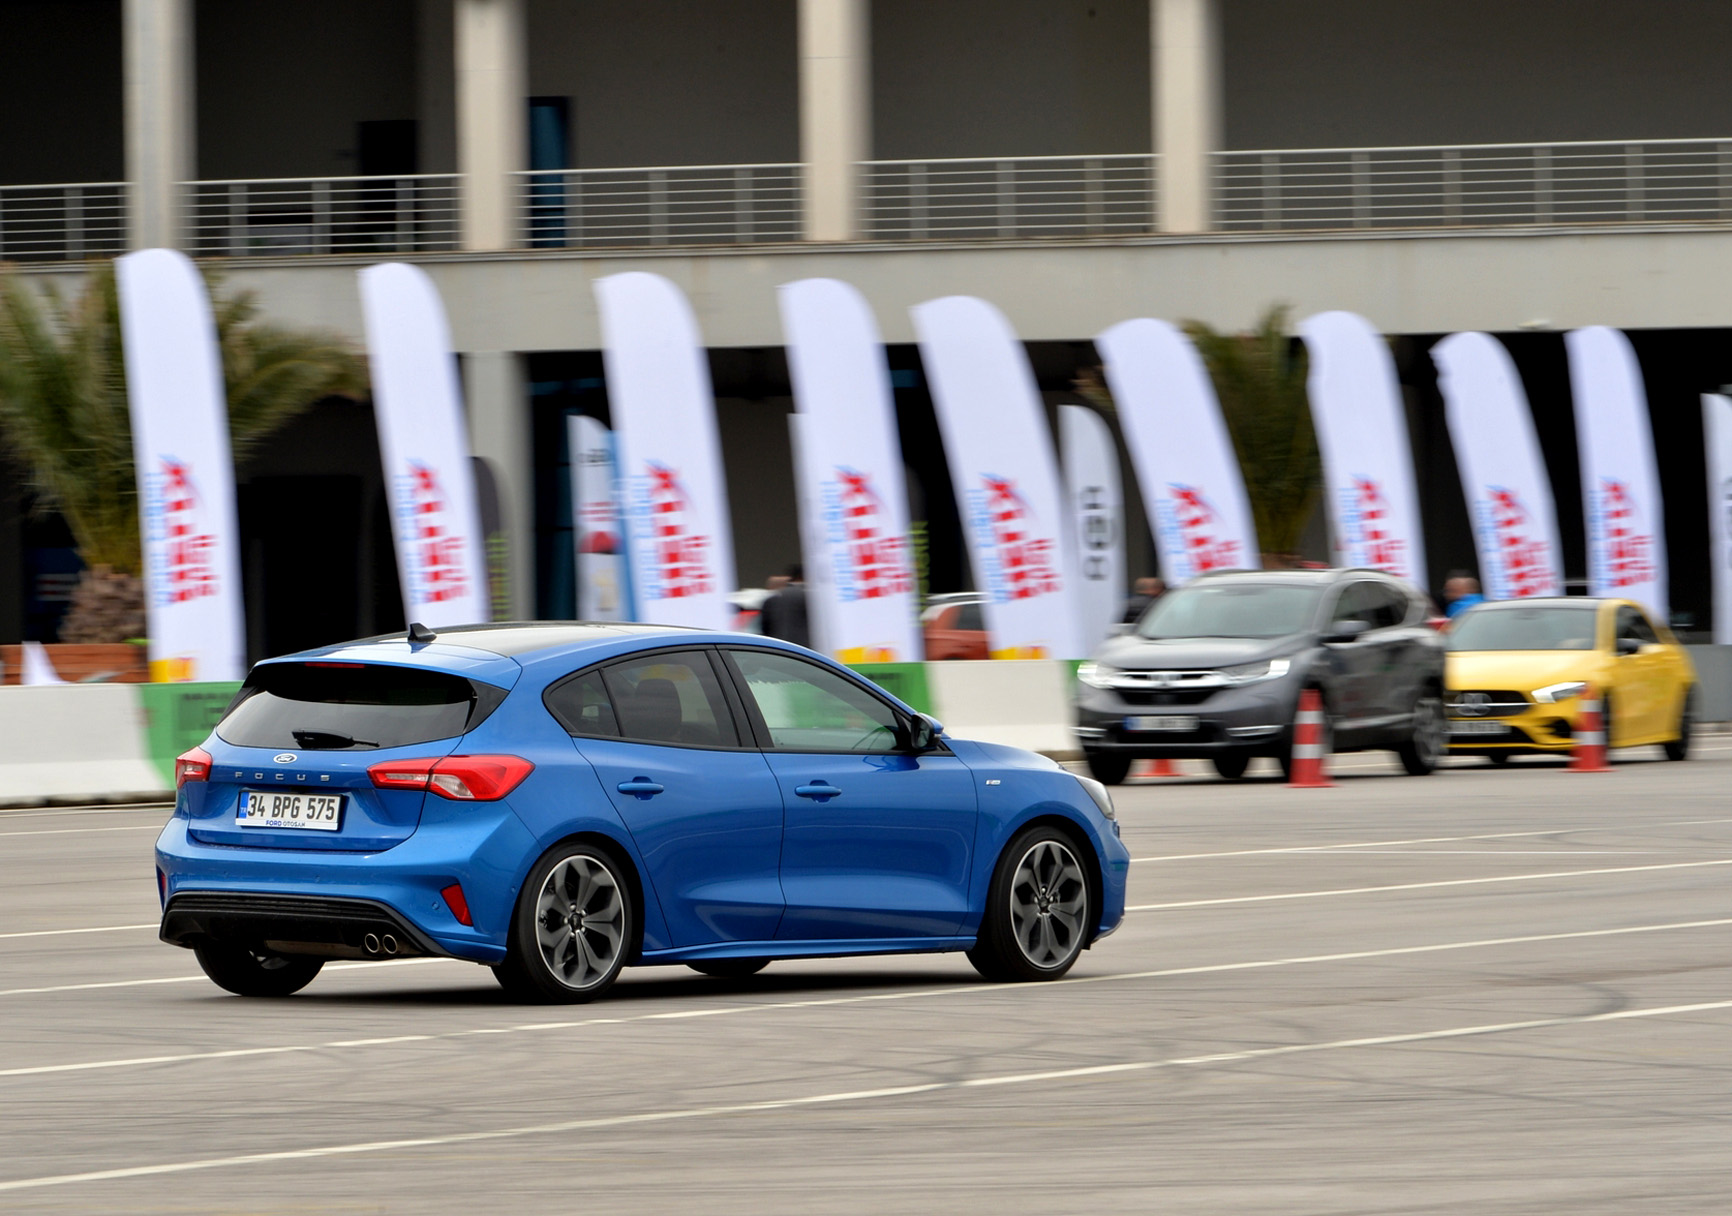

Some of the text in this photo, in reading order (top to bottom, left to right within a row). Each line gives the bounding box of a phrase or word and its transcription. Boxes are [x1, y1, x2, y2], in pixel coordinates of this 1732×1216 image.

[235, 771, 330, 782] FOCUS
[248, 795, 336, 821] 34 BPG 575
